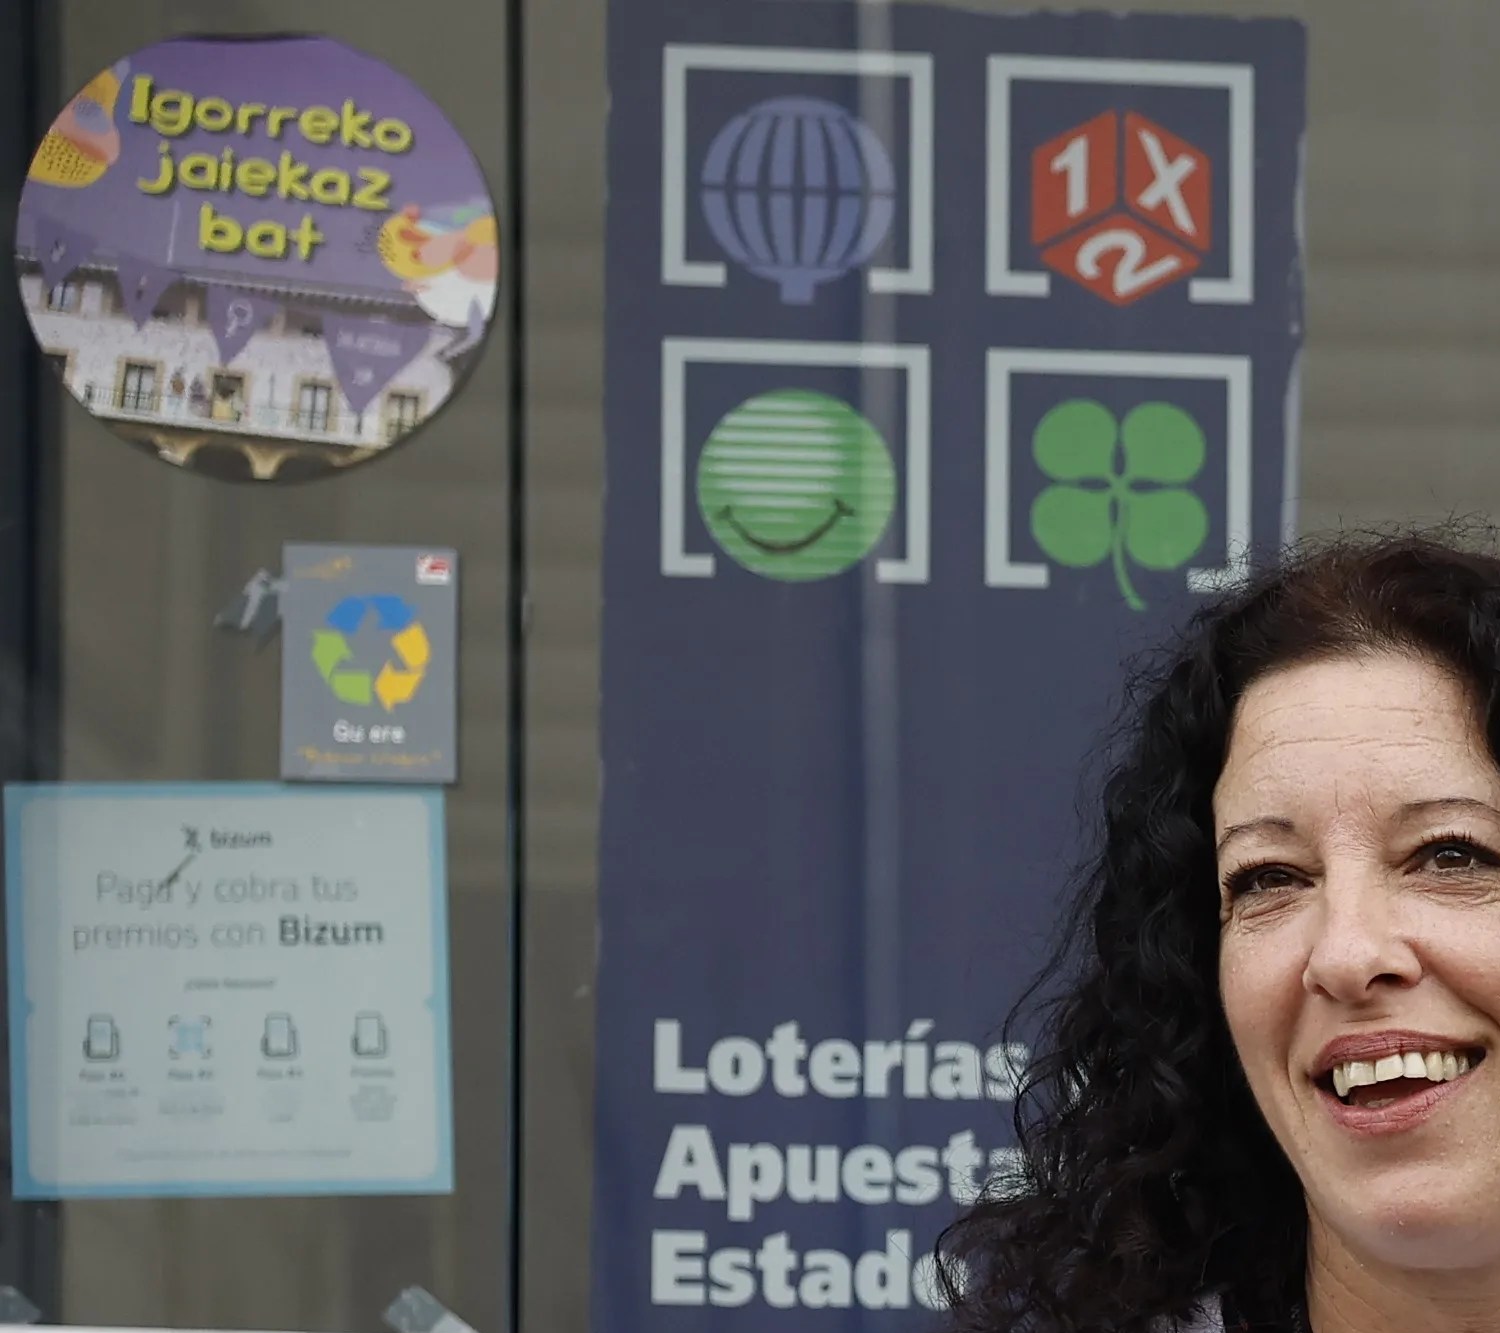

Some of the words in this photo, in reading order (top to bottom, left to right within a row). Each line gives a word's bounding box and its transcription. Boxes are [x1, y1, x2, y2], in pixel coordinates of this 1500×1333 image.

[130, 76, 413, 153] Igorreko
[137, 144, 392, 211] jaiekaz
[200, 204, 323, 261] bat
[312, 875, 358, 902] tus
[73, 919, 198, 952] premios
[210, 924, 265, 948] con
[278, 913, 385, 947] Bizum
[653, 1018, 1030, 1100] Loterías
[653, 1124, 1038, 1222] Apuesta
